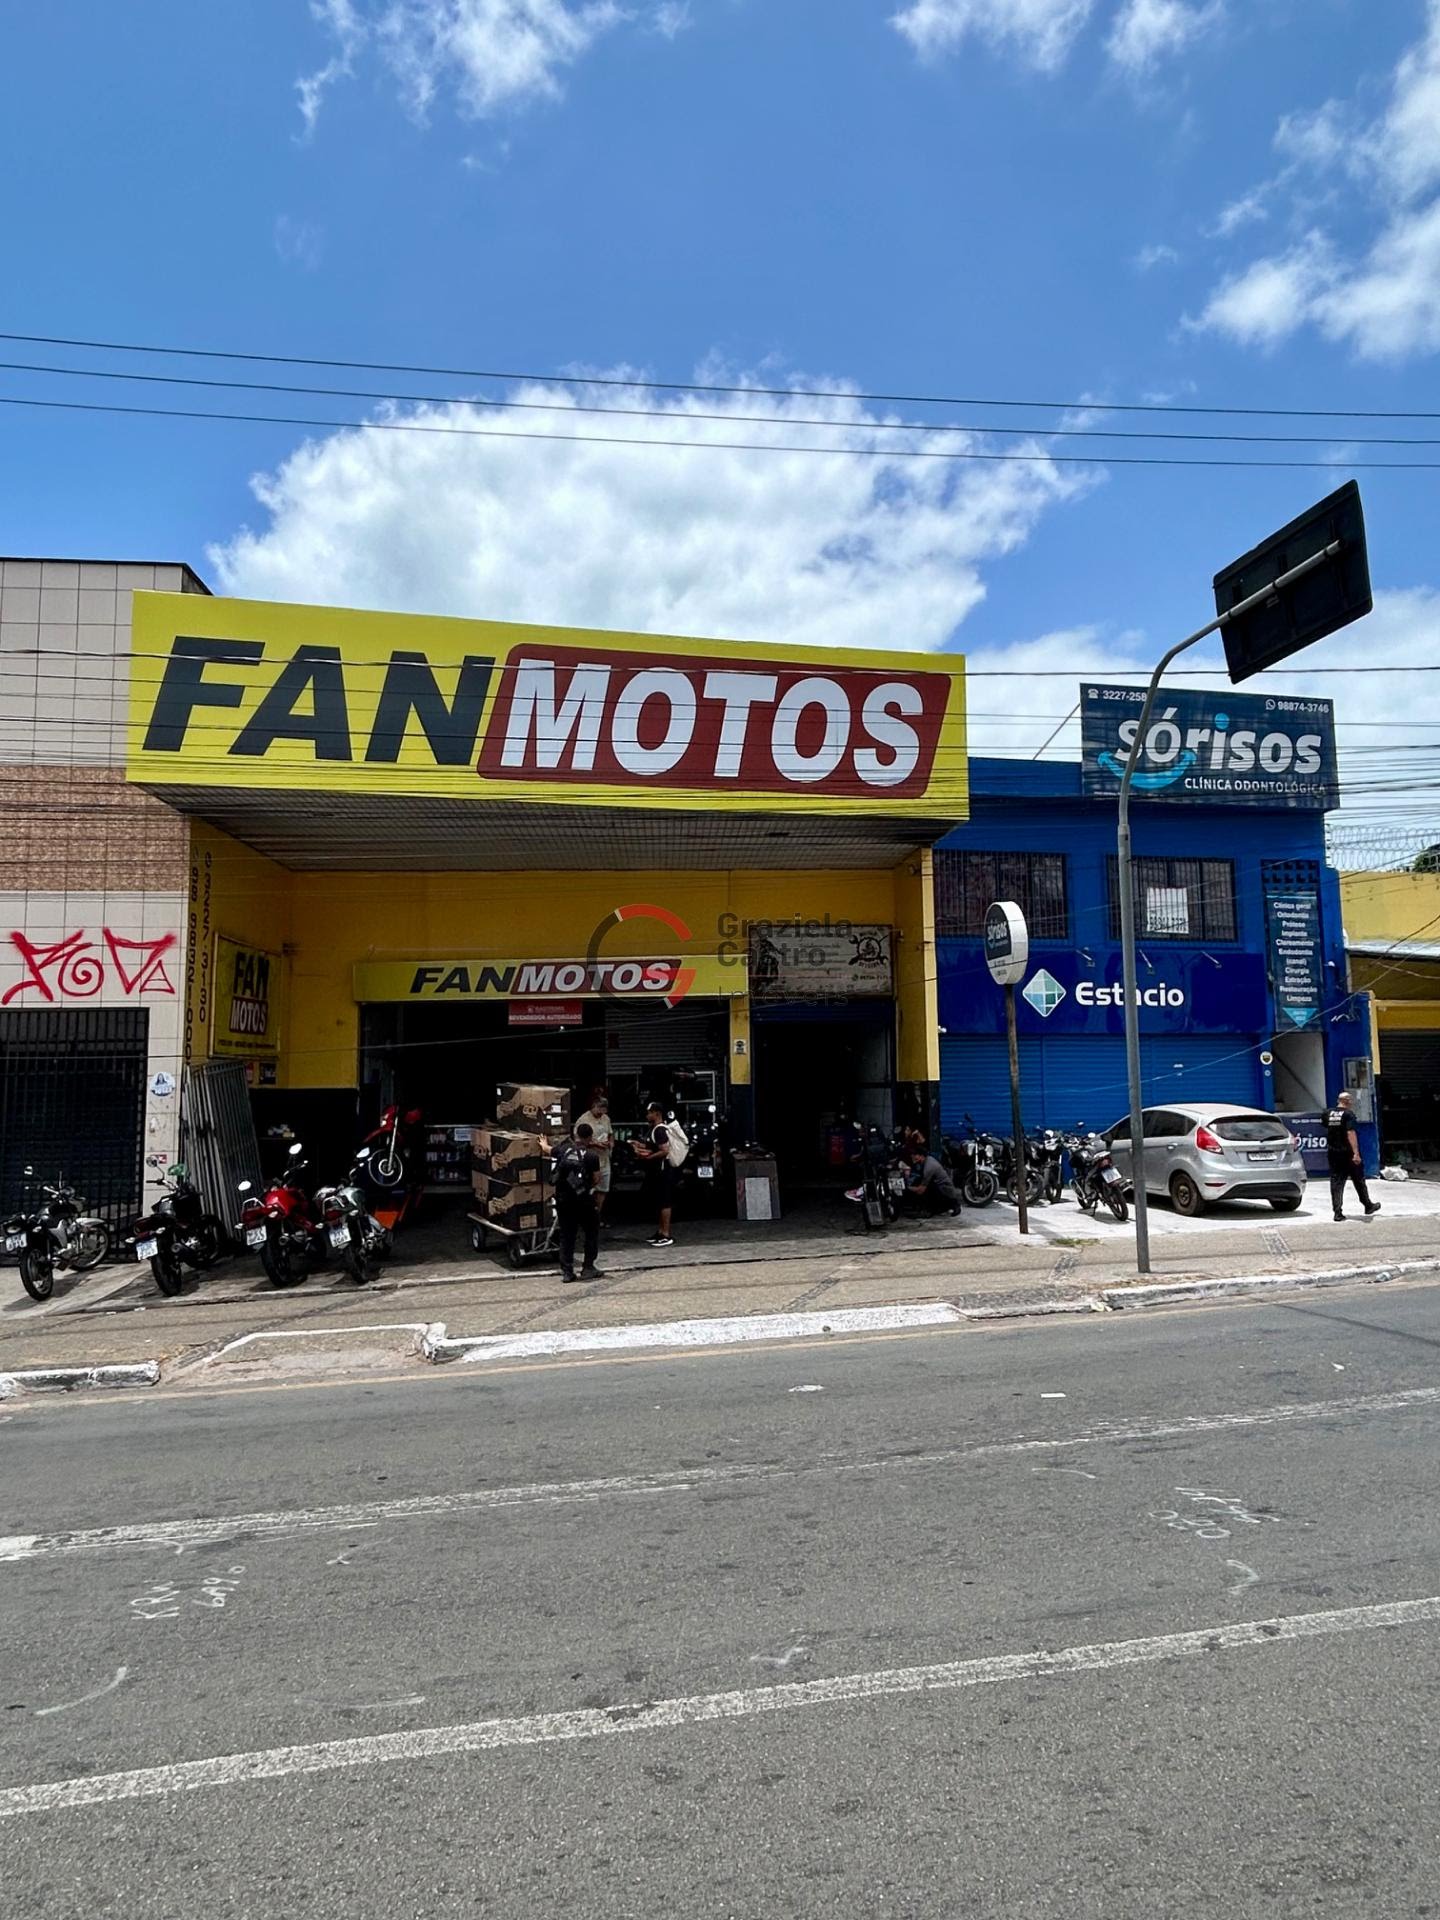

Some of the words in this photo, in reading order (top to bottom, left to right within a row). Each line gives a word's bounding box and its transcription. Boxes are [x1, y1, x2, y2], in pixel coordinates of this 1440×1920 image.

[142, 635, 495, 766] FAN
[499, 657, 924, 788] MOTOS
[1102, 690, 1148, 702] 3227-258
[1184, 776, 1232, 791] CLÍNICA
[233, 952, 270, 1000] FAN
[409, 966, 517, 994] FAN
[517, 961, 672, 993] MOTOS
[230, 1000, 267, 1033] MOTOS
